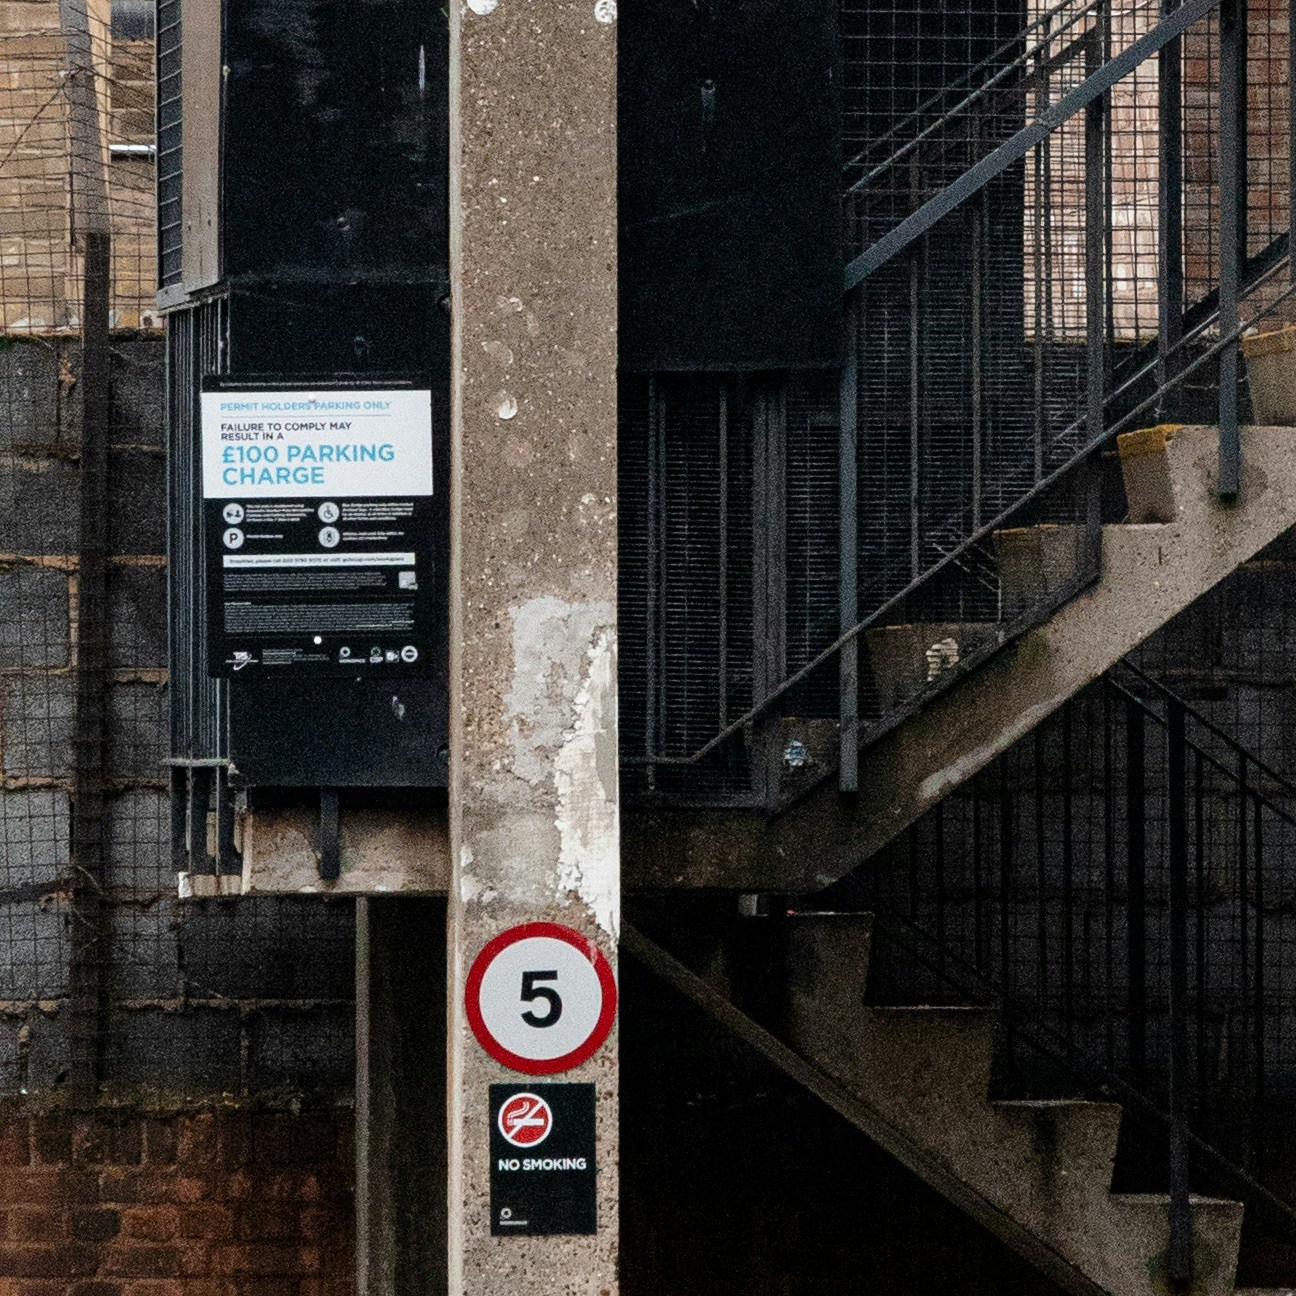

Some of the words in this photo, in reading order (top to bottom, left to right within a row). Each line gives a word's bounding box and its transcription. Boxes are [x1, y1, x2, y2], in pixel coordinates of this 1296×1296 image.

[220, 402, 259, 412] PERMIT
[262, 401, 310, 411] HOLDERS
[314, 401, 361, 411] PARKING
[363, 400, 392, 410] ONLY
[220, 423, 264, 432] FAILURE
[267, 423, 282, 431] TO
[284, 422, 326, 432] COMPLY
[329, 422, 352, 430] MAY
[220, 433, 259, 441] RESULT
[262, 432, 273, 440] IN
[276, 432, 284, 440] A
[222, 445, 279, 464] £100
[286, 444, 395, 463] PARKING
[222, 466, 325, 485] CHARGE
[520, 970, 563, 1028] 5
[498, 1158, 520, 1171] NO
[522, 1157, 587, 1171] SMOKING
